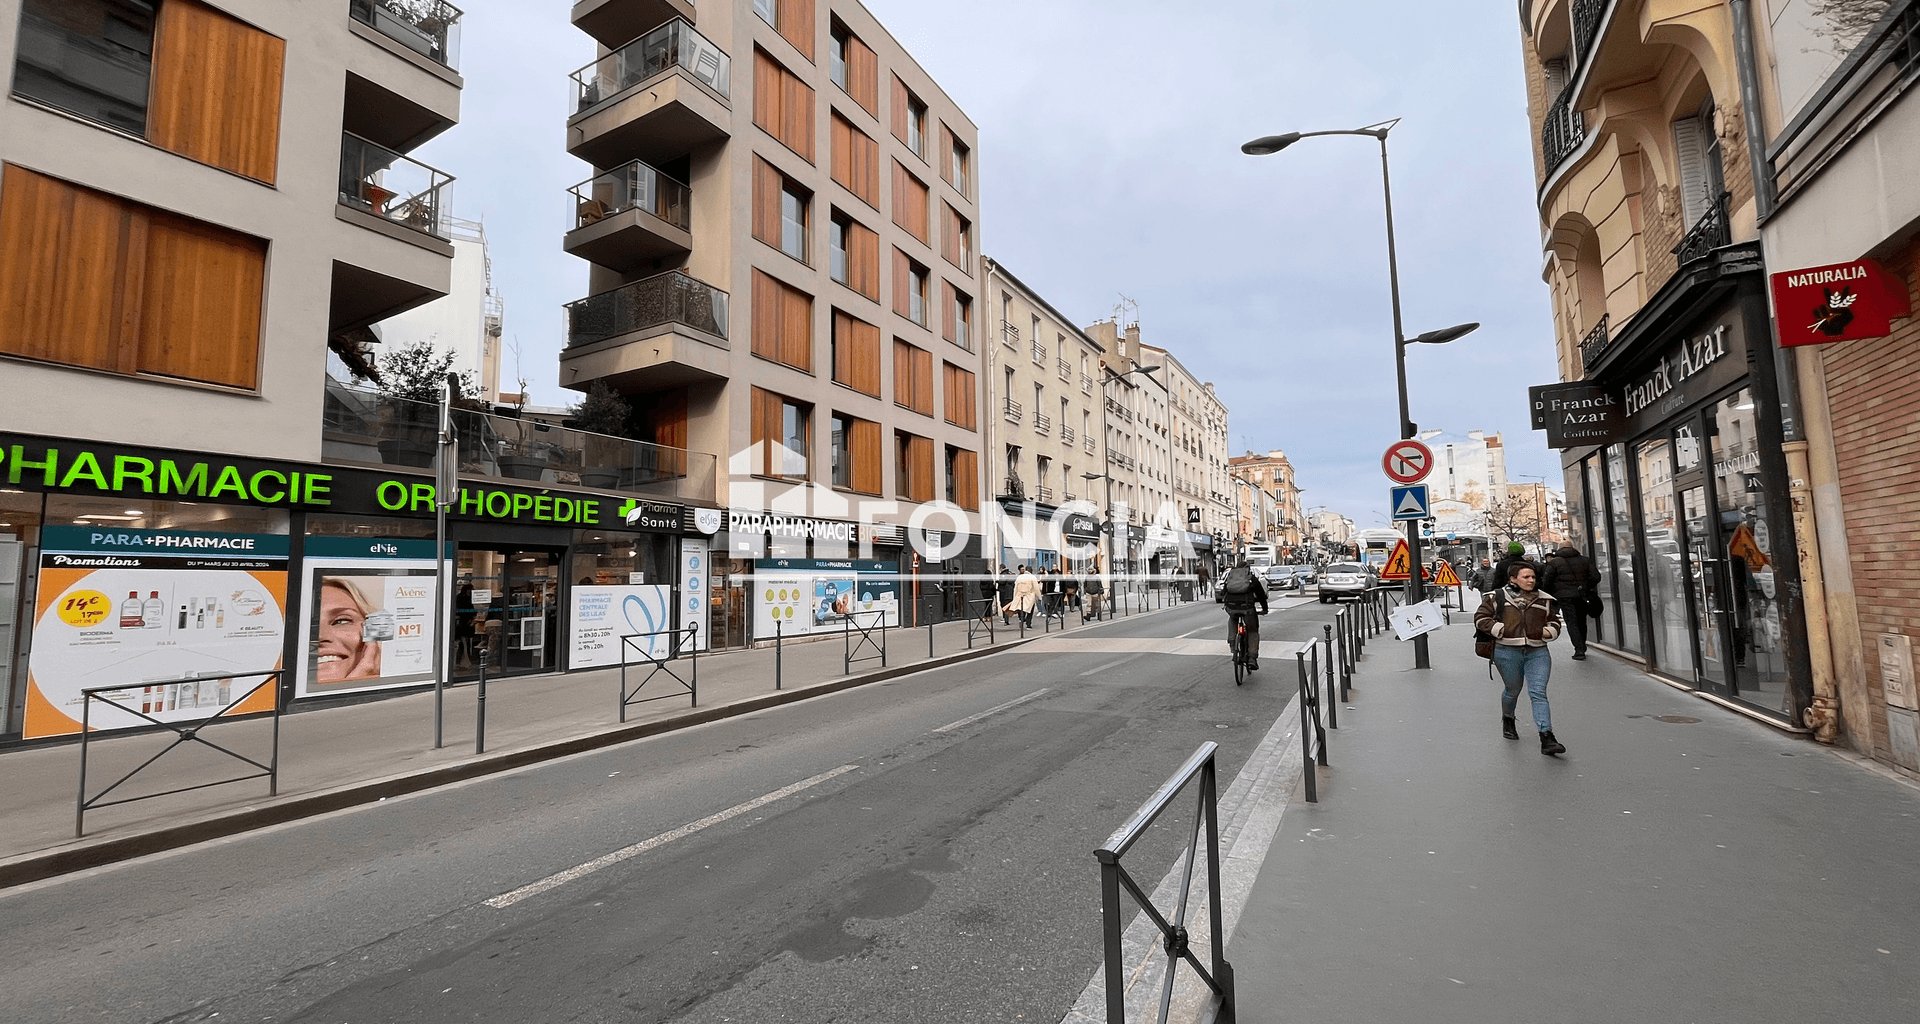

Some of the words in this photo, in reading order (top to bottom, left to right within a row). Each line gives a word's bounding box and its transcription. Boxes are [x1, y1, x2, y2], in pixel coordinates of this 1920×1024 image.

[1787, 266, 1867, 289] NATURALIA
[1623, 356, 1673, 418] Franck
[1679, 323, 1727, 383] Azar
[1551, 394, 1616, 412] Franck
[1563, 412, 1607, 425] Azar
[1563, 429, 1609, 439] Coiffure
[1714, 450, 1760, 478] MASCULIN
[0, 444, 333, 505] HARMACIE
[376, 479, 600, 524] ORHOPÉDIE
[641, 501, 678, 515] Pharma
[641, 516, 678, 529] Santé
[729, 511, 856, 543] PARAPHARMACIE
[91, 532, 255, 550] PARA+PHARMACIE
[53, 554, 142, 567] Promotions
[395, 585, 428, 597] Avène
[399, 624, 422, 636] N°1
